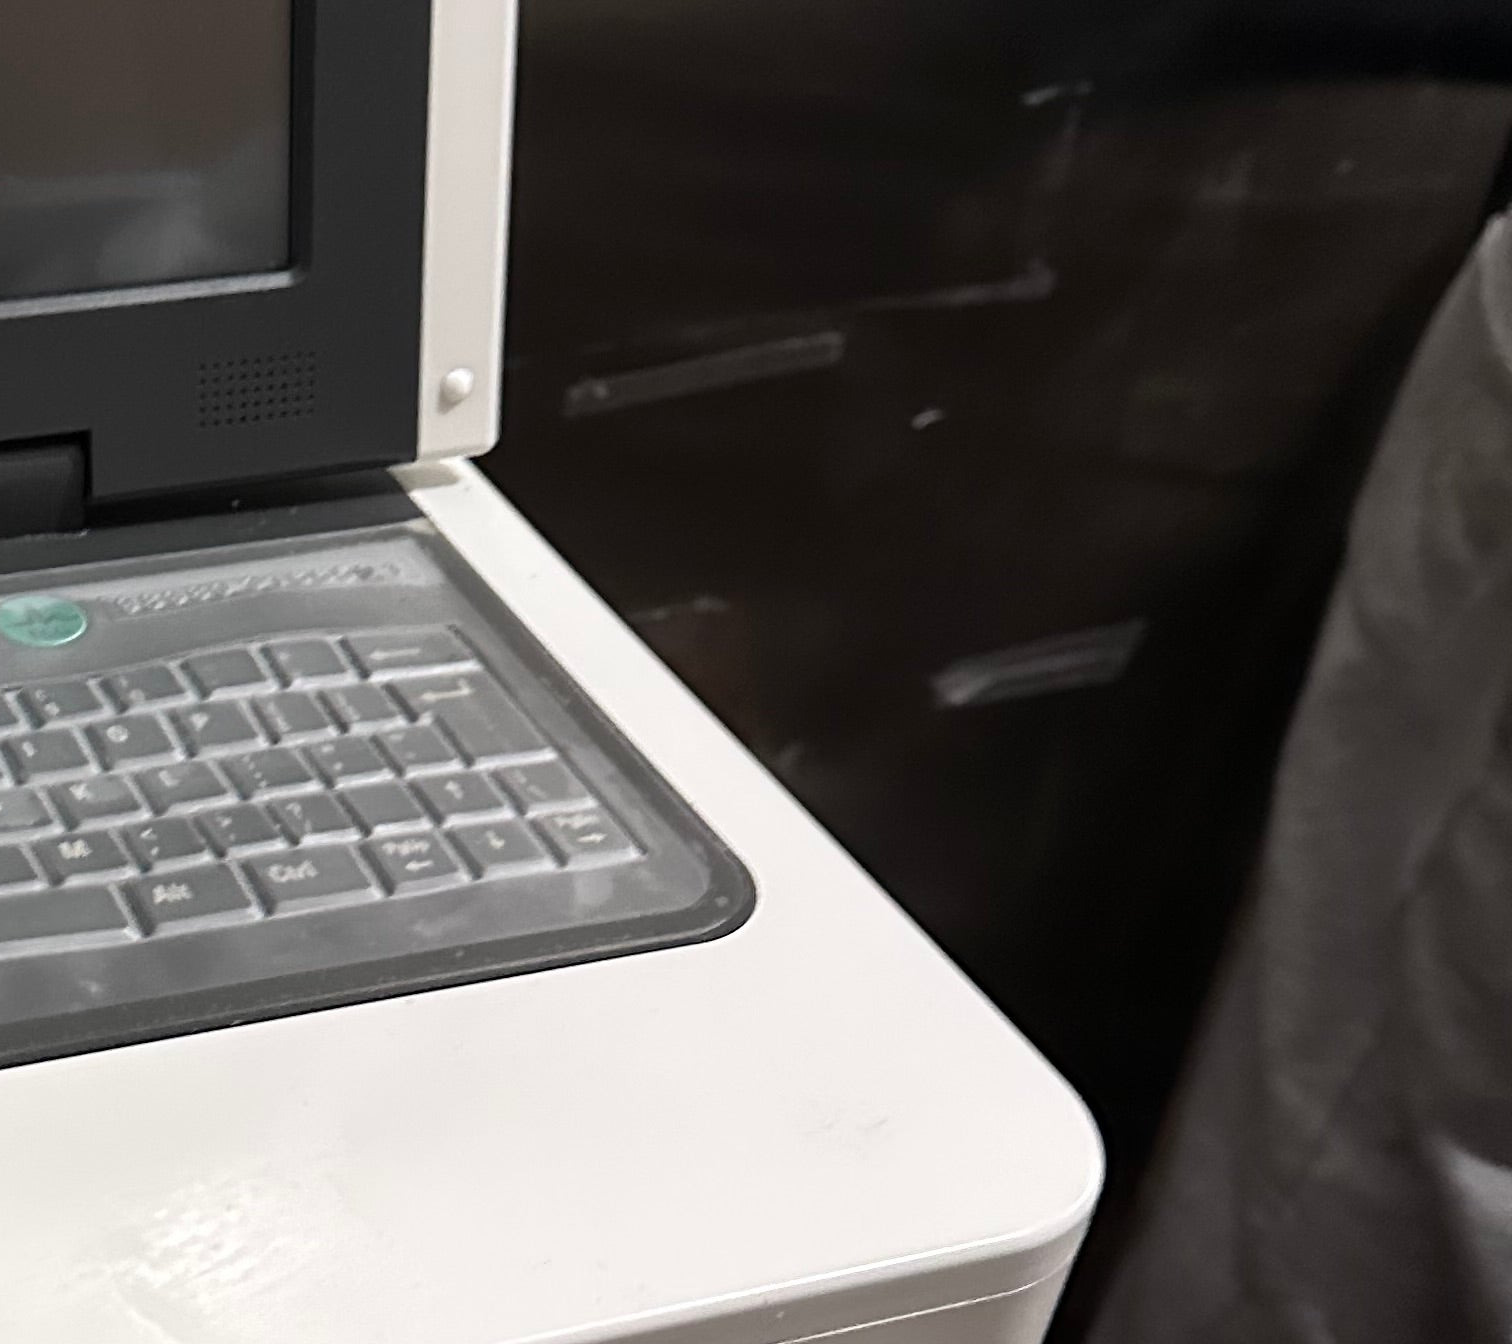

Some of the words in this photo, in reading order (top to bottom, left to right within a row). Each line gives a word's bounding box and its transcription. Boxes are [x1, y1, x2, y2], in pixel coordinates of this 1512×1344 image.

[58, 839, 93, 860] M
[267, 859, 320, 883] Ctrl
[152, 883, 194, 905] Alt
